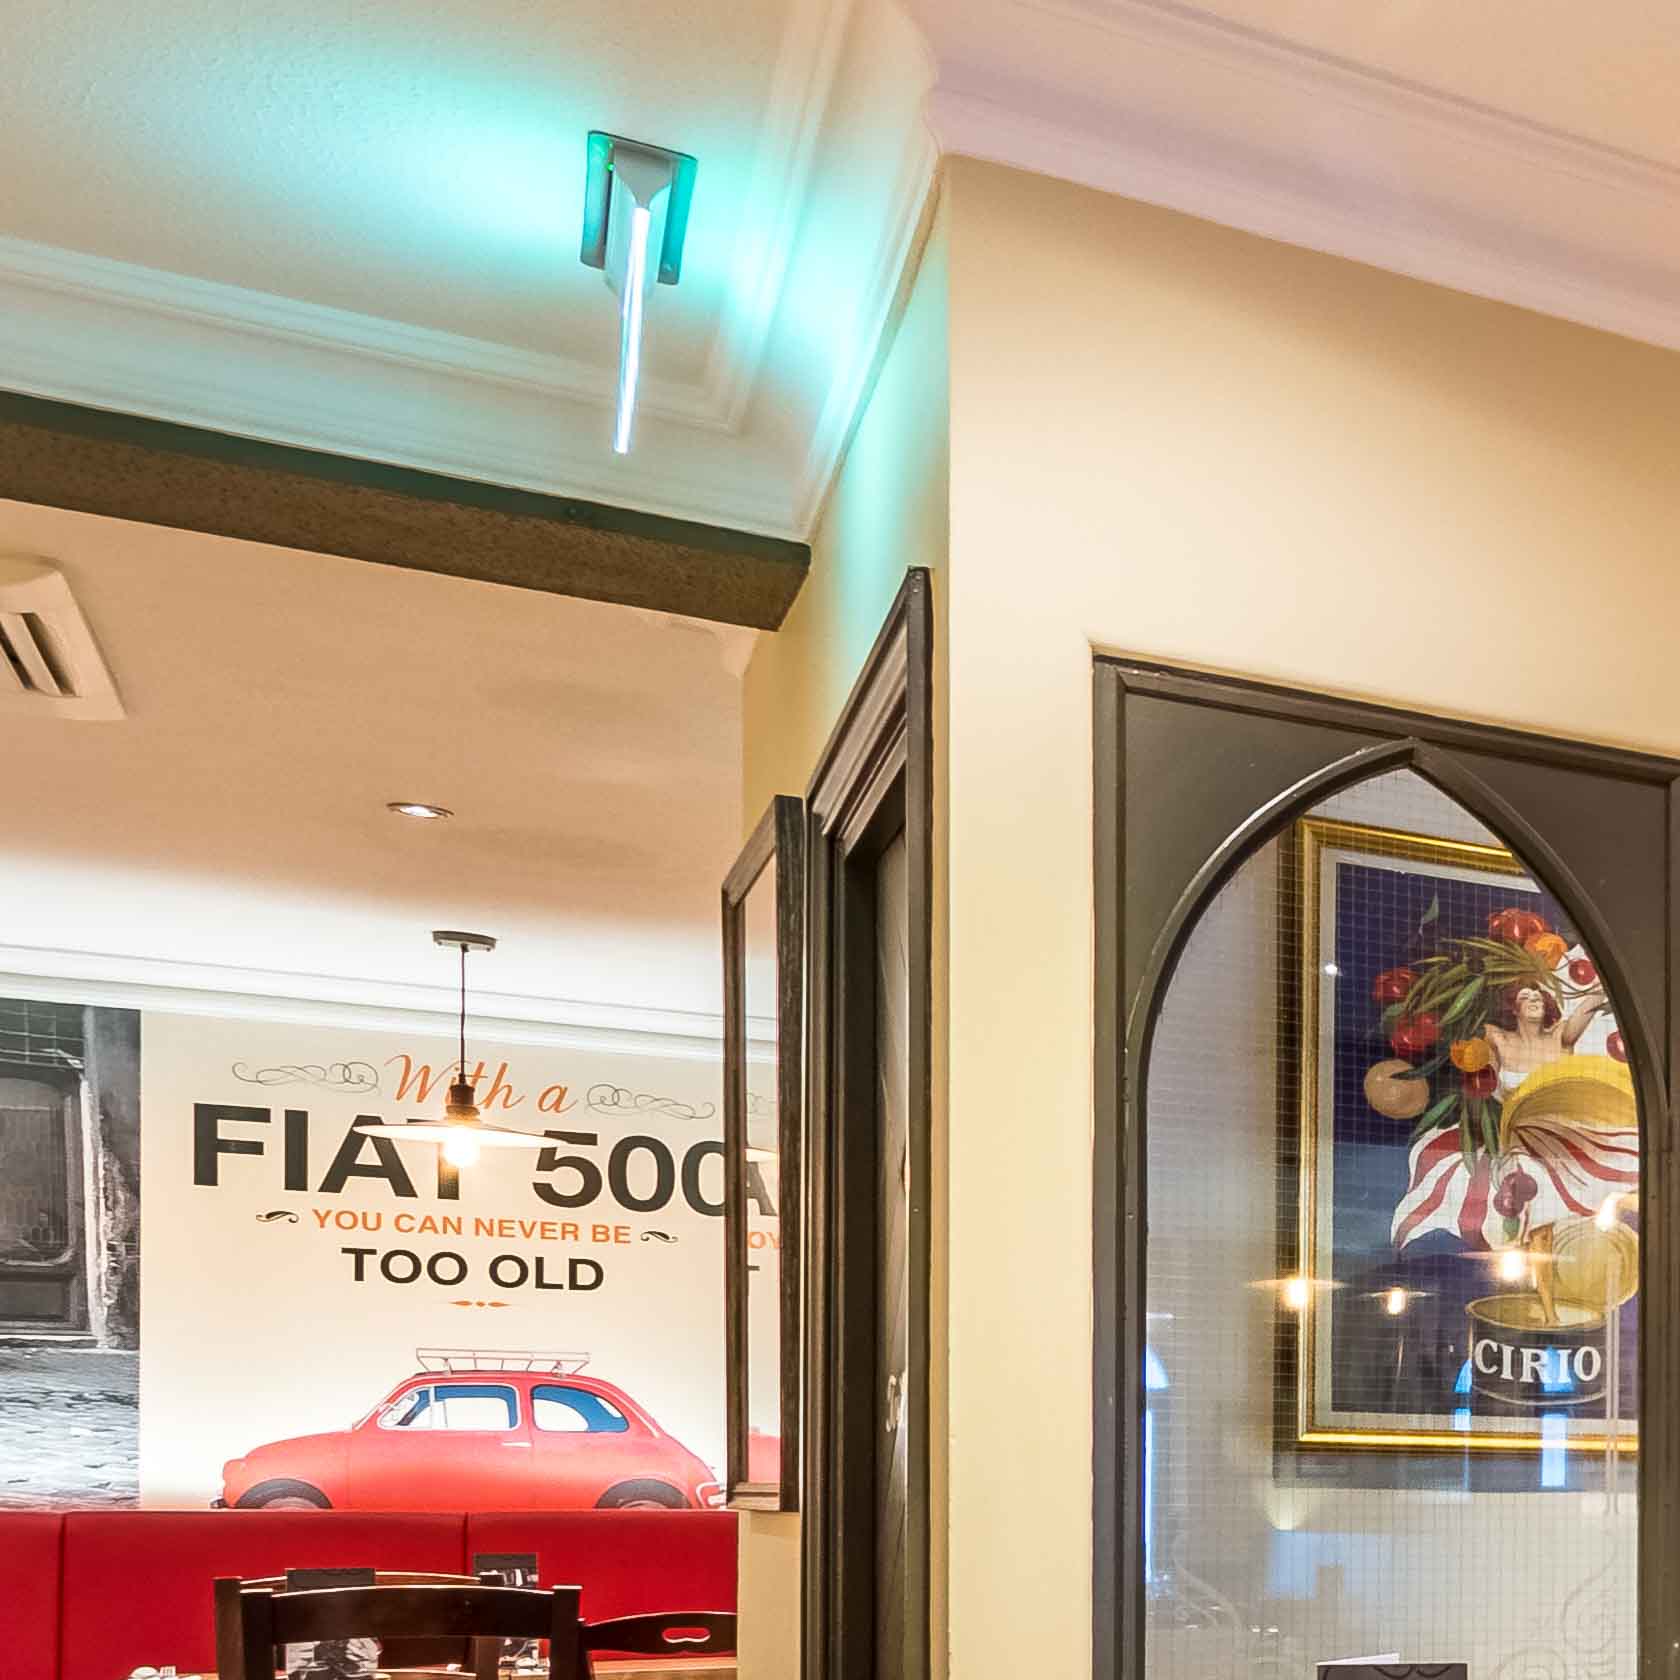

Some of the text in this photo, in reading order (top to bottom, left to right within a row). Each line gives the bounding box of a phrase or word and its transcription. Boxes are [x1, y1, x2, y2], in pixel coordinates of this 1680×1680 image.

[537, 1083, 578, 1113] a
[311, 1208, 632, 1244] YOU CAN NEVER BE
[341, 1247, 605, 1292] TOO OLD
[1474, 1338, 1601, 1384] CIRIO
